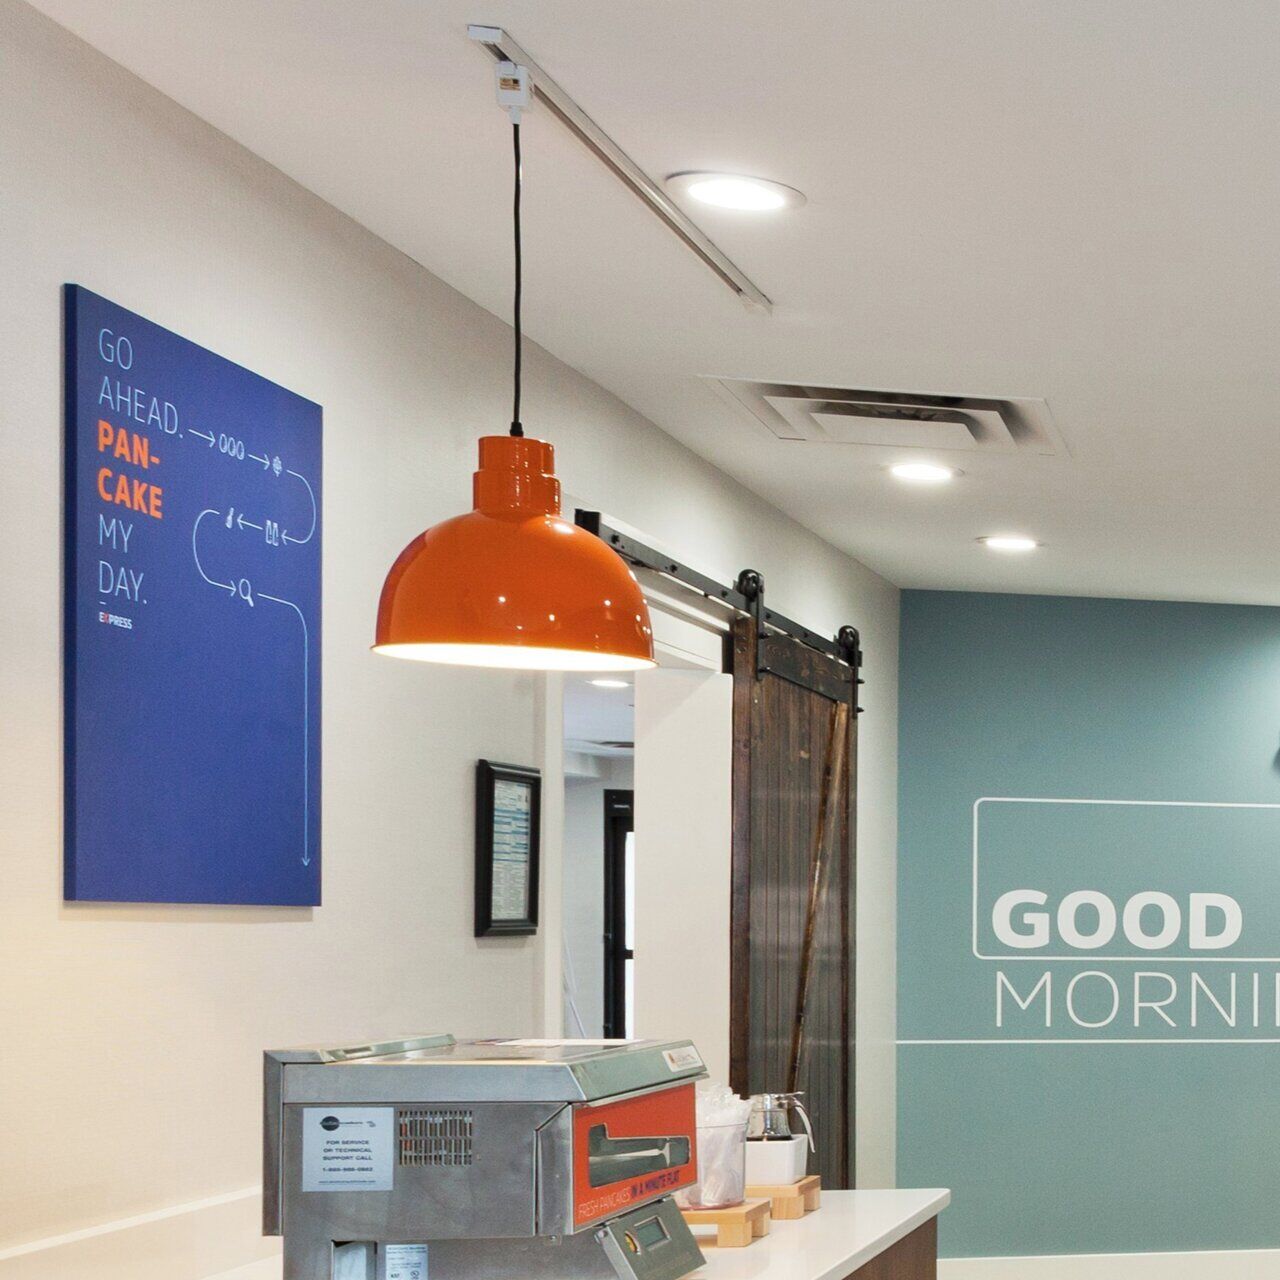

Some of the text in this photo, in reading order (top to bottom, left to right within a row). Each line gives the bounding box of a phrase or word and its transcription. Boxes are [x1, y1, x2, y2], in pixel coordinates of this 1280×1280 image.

[99, 328, 133, 370] GO
[98, 376, 184, 438] AHEAD.
[98, 419, 160, 469] PAN-
[98, 468, 163, 519] CAKE
[99, 513, 133, 553] MY
[99, 560, 148, 605] DAY.
[99, 611, 133, 630] EXPRESS
[992, 889, 1243, 950] GOOD
